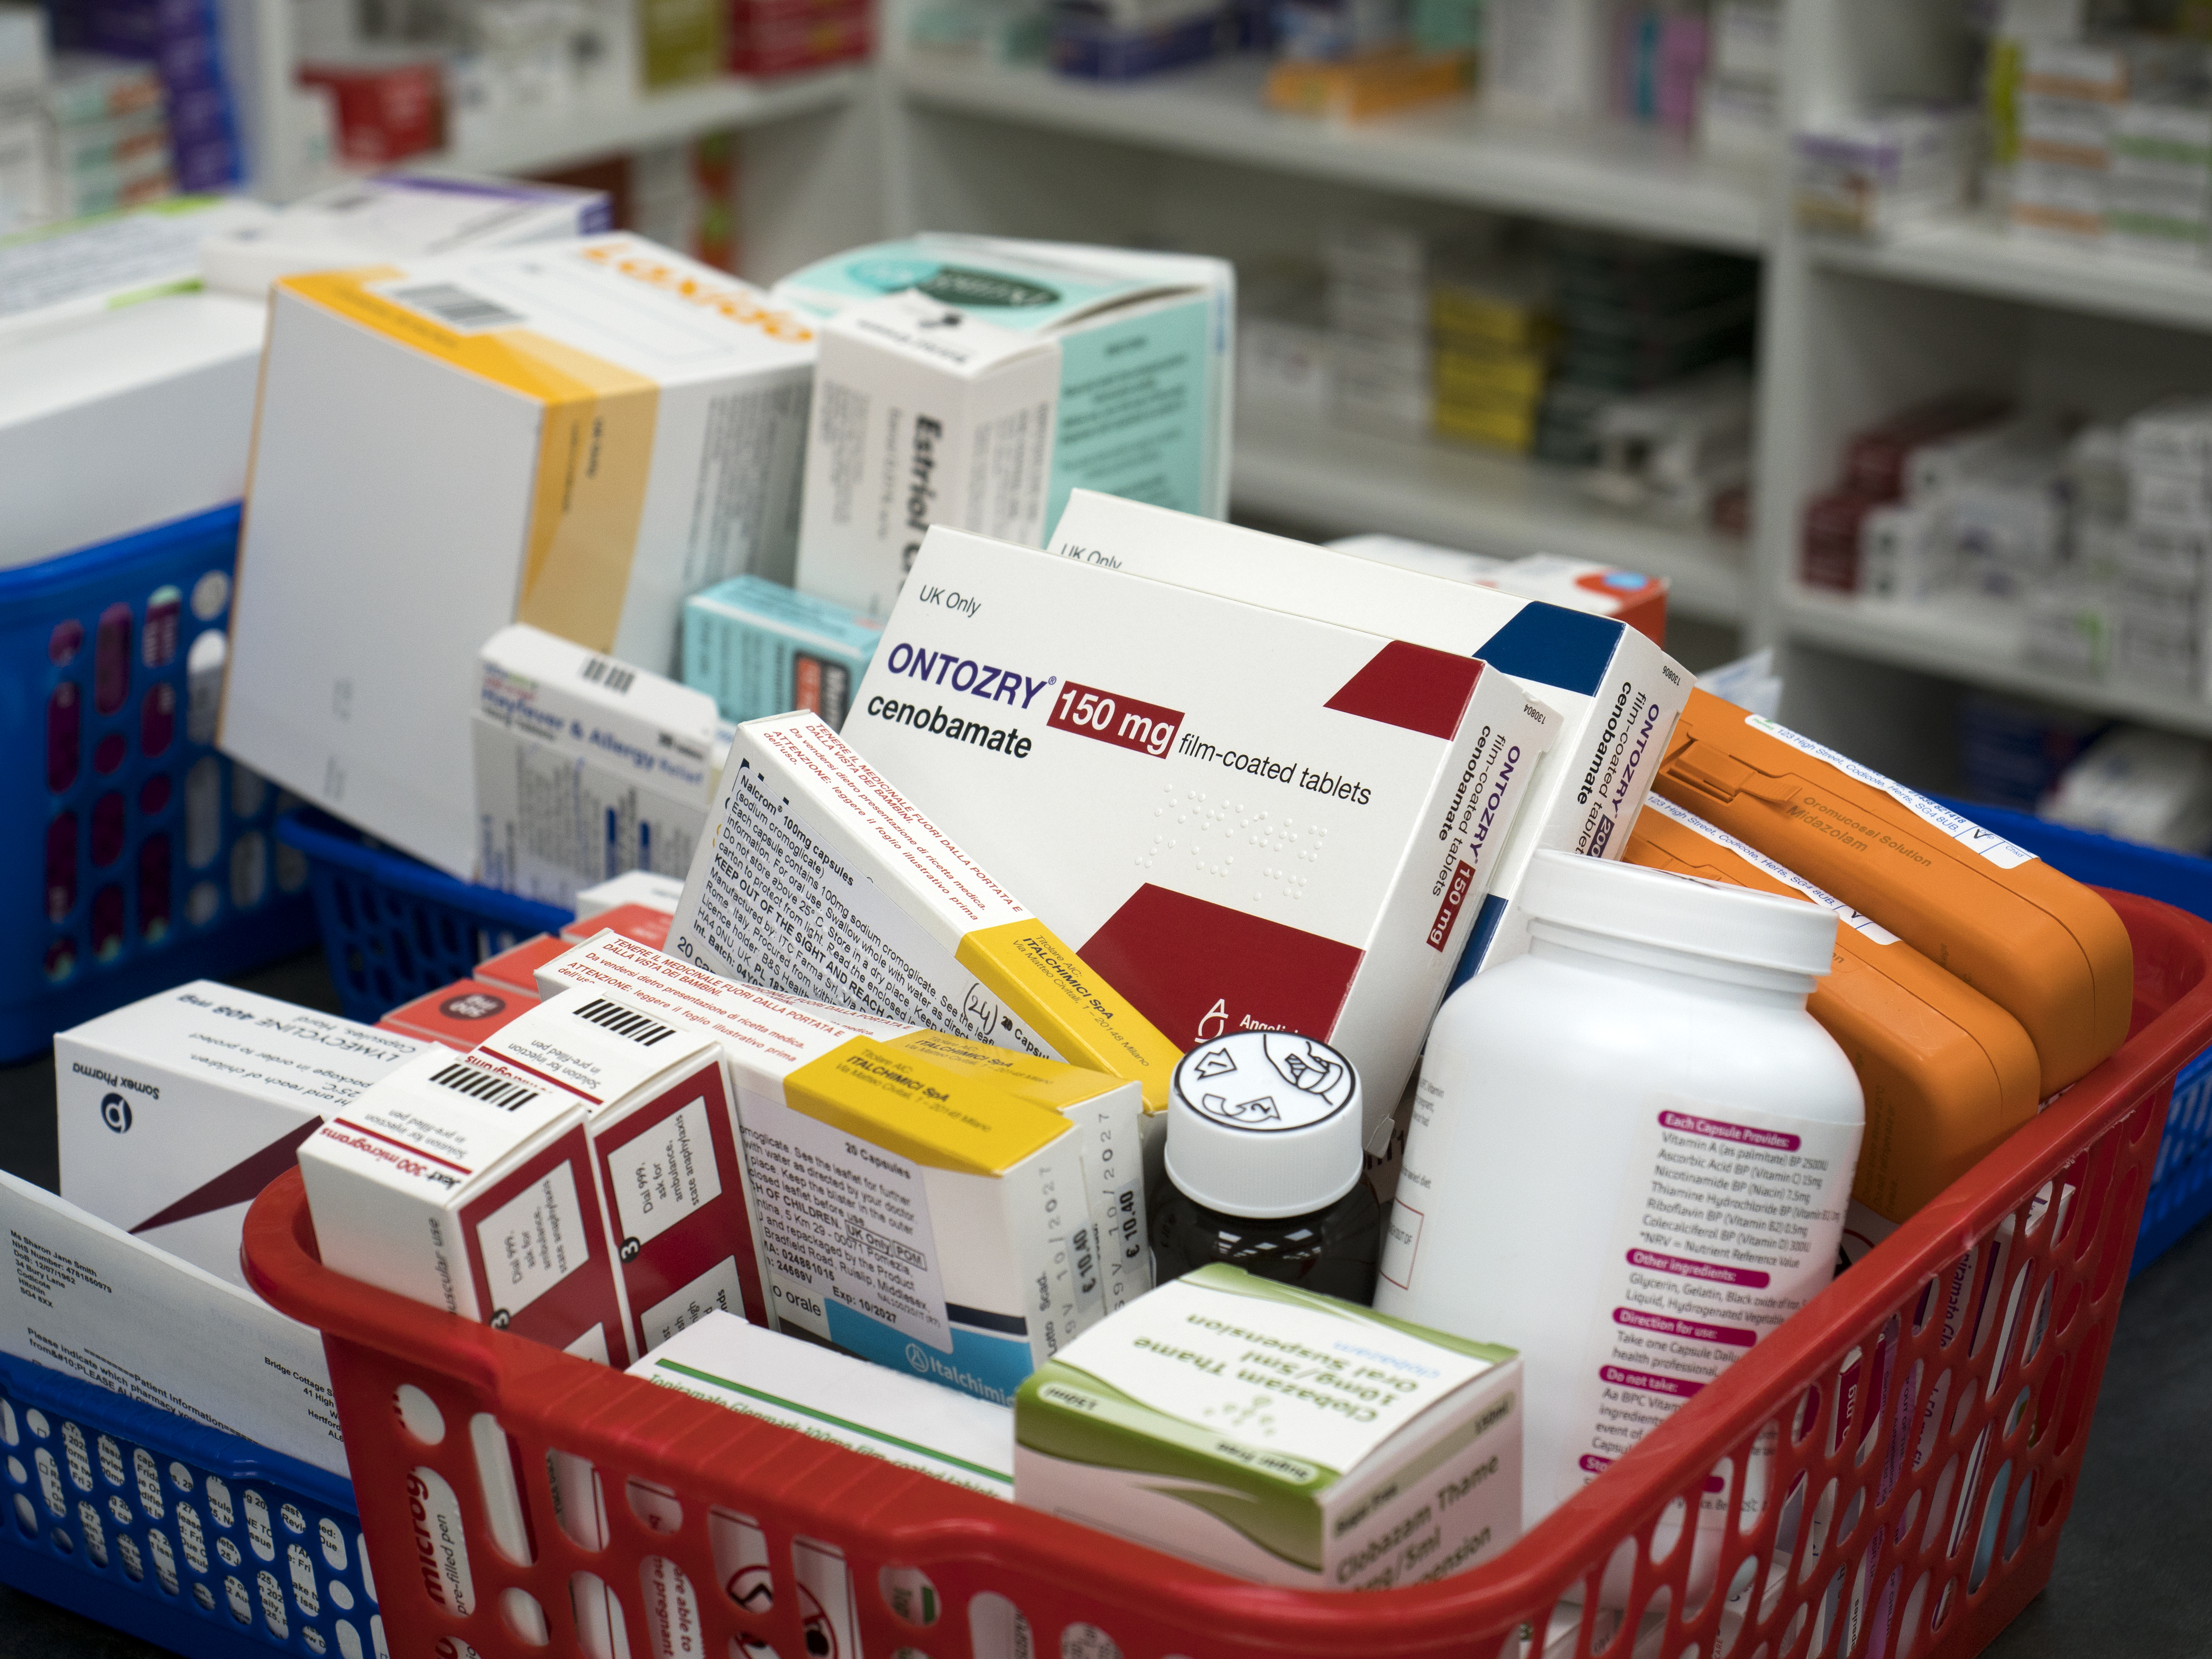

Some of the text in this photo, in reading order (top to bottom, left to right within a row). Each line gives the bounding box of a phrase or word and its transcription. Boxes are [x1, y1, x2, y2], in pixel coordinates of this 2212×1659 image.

[582, 242, 816, 344] Laxido
[920, 585, 981, 617] UK Only
[1662, 665, 1681, 686] 130806
[867, 696, 1031, 758] cenobamate
[1523, 703, 1546, 725] 130804
[1577, 682, 1631, 804] cenobamate
[763, 733, 797, 764] dell'uso.
[806, 725, 913, 823] DALLA VISTA DEI BAMBINI.
[1059, 690, 1115, 730] 150
[1118, 713, 1174, 754] mg
[1179, 733, 1297, 783] film-coated
[1299, 768, 1371, 804] tablets
[1575, 692, 1646, 854] film-coated tablet
[1439, 725, 1490, 840] cenobamate
[1778, 729, 1958, 831] 123 High Street, Codicote, Herts, SG4 8UB.
[736, 789, 824, 879] (sodium cromoglicate)
[772, 732, 831, 783] ATTENZIONE:
[832, 786, 865, 815] leggere
[875, 827, 901, 848] foglio
[902, 852, 949, 893] illustrativo
[949, 897, 978, 920] prima
[789, 728, 802, 738] Da
[803, 740, 838, 770] vendersi
[836, 772, 860, 792] dietro
[858, 794, 917, 844] presentazione
[926, 856, 954, 879] ricetta
[953, 881, 985, 910] medica.
[816, 723, 851, 754] TENERE
[859, 765, 914, 812] MEDICINALE
[912, 814, 942, 837] FUORI
[940, 840, 970, 865] DALLA
[970, 867, 1013, 904] PORTATA
[1432, 734, 1505, 896] film-coated tablets
[1587, 819, 1613, 857] 200
[1787, 803, 1868, 854] Midazolam
[1803, 797, 1931, 866] Oromucosal Solution
[783, 816, 812, 850] 100mg
[813, 845, 853, 885] capsules
[732, 801, 973, 1031] Each capsule contains 100mg sodium cromoglicate. See the
[1449, 868, 1471, 905] 150
[714, 854, 884, 1020] KEEP OUT OF THE SIGHT AND REACH
[1036, 935, 1082, 977] Titolare AIC:
[1430, 908, 1452, 945] mg
[614, 938, 653, 957] TENERE
[661, 959, 723, 986] MEDICINALE
[721, 984, 754, 999] FUORI
[752, 997, 786, 1013] DALLA
[786, 1011, 833, 1033] PORTATA
[1013, 940, 1026, 952] Via
[1025, 953, 1053, 977] Matteo
[1054, 979, 1080, 1003] Civitali,
[1094, 1018, 1123, 1040] 20148
[1122, 1042, 1149, 1066] Milano
[1022, 938, 1113, 1019] ITALCHIMICI SpA
[73, 1062, 159, 1100] Somex Pharma
[508, 1043, 600, 1089] Solution for injection
[319, 1126, 461, 1189] Jext 300 micrograms
[1665, 1114, 1789, 1147] Each Capsule Provides:
[636, 1163, 653, 1214] Dial 999,
[666, 1140, 682, 1202] ambulance,
[11, 1230, 96, 1277] Ms Sharon Jane Smith
[12, 1240, 29, 1253] NHS
[30, 1249, 64, 1270] Number:
[14, 1249, 75, 1284] DoB: 12/07/1962
[15, 1259, 65, 1288] 34 Bury Lane
[17, 1268, 50, 1289] Codicote
[18, 1278, 45, 1295] Hitchin
[786, 1291, 821, 1316] orale
[27, 1327, 176, 1414] Please indicate which pharmacy
[265, 1356, 324, 1392] Bridge Cottage
[1132, 1335, 1377, 1421] Clobazam Thame
[1187, 1315, 1417, 1391] Oral Suspension
[1241, 1351, 1395, 1406] 10mg/5ml
[308, 1409, 341, 1432] Hertford
[437, 1514, 470, 1615] pre-filled pen
